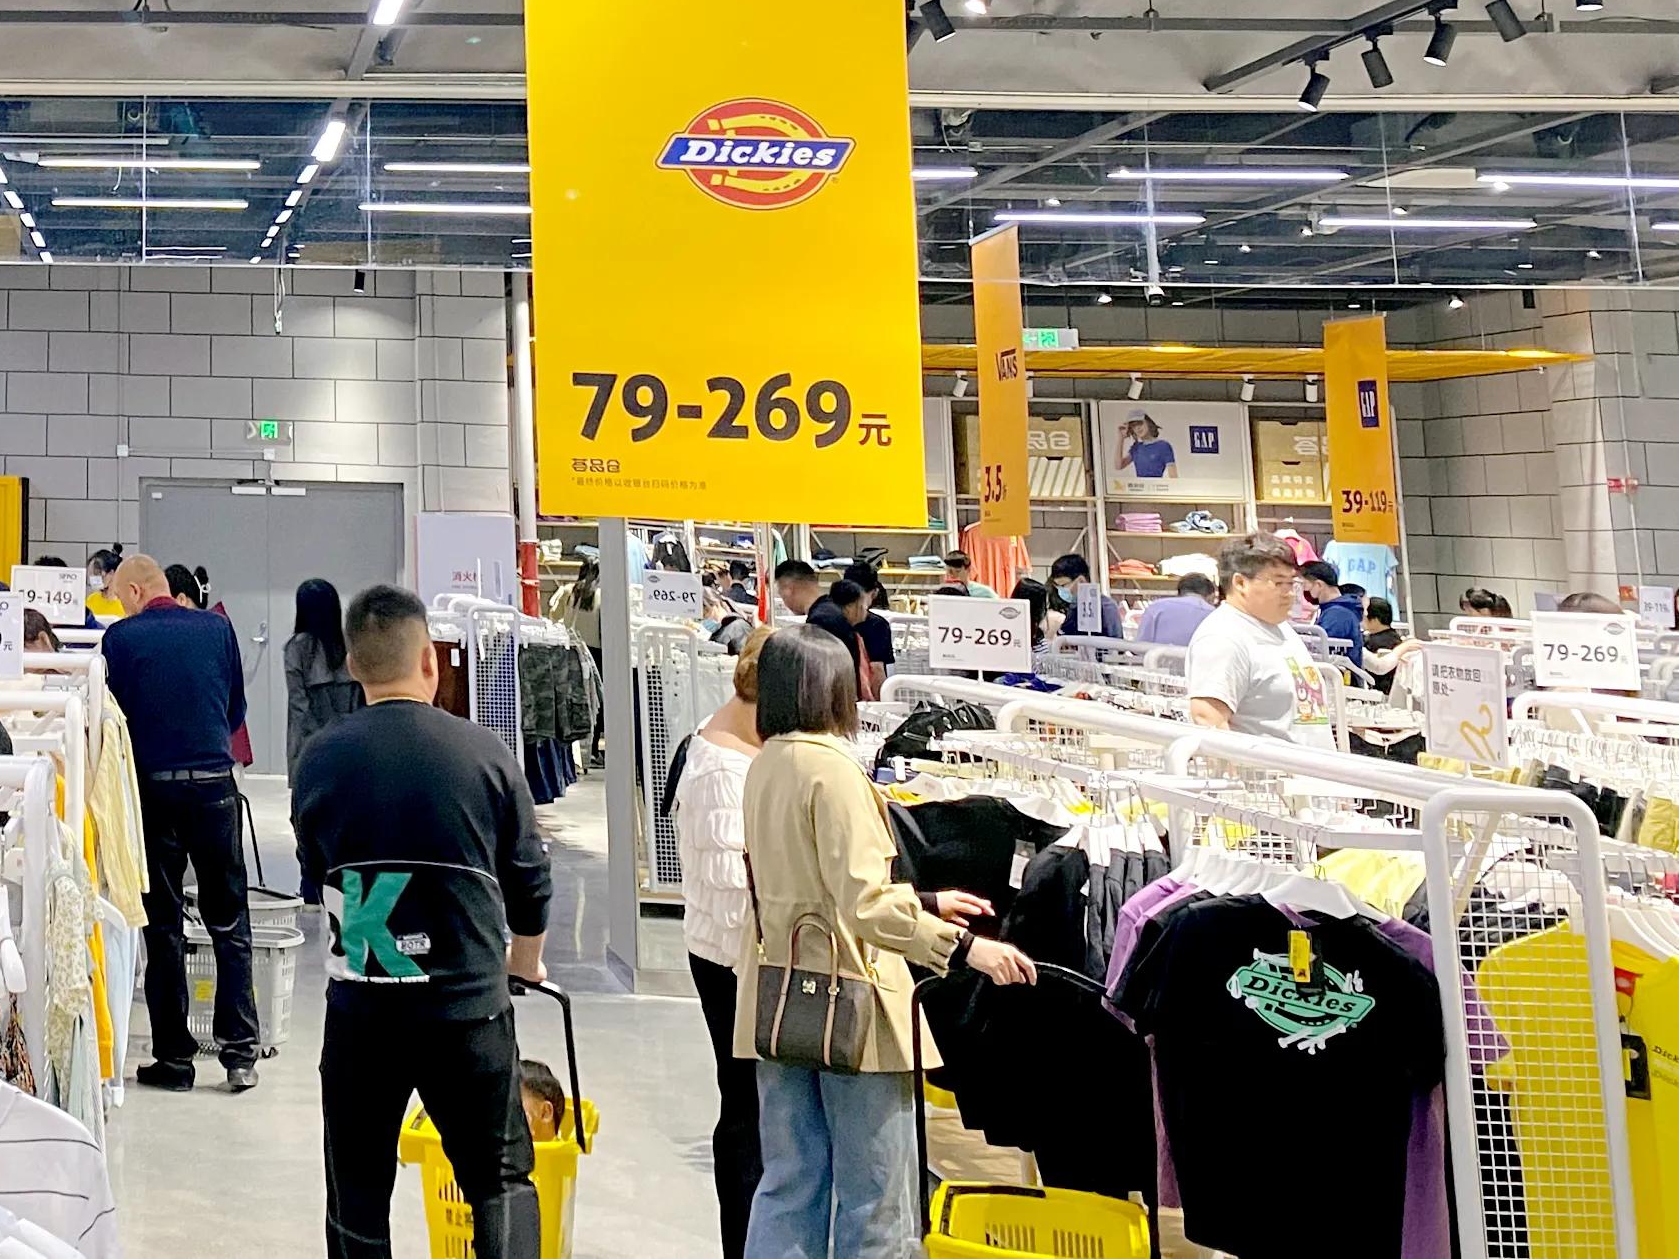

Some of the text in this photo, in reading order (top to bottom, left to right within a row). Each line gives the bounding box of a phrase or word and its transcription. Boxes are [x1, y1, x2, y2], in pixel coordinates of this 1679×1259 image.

[679, 139, 836, 167] Dickies
[995, 349, 1018, 381] VANS
[1361, 391, 1376, 418] GAP
[1193, 431, 1215, 449] GAP
[1347, 555, 1377, 573] GAP
[452, 571, 483, 582] 消火
